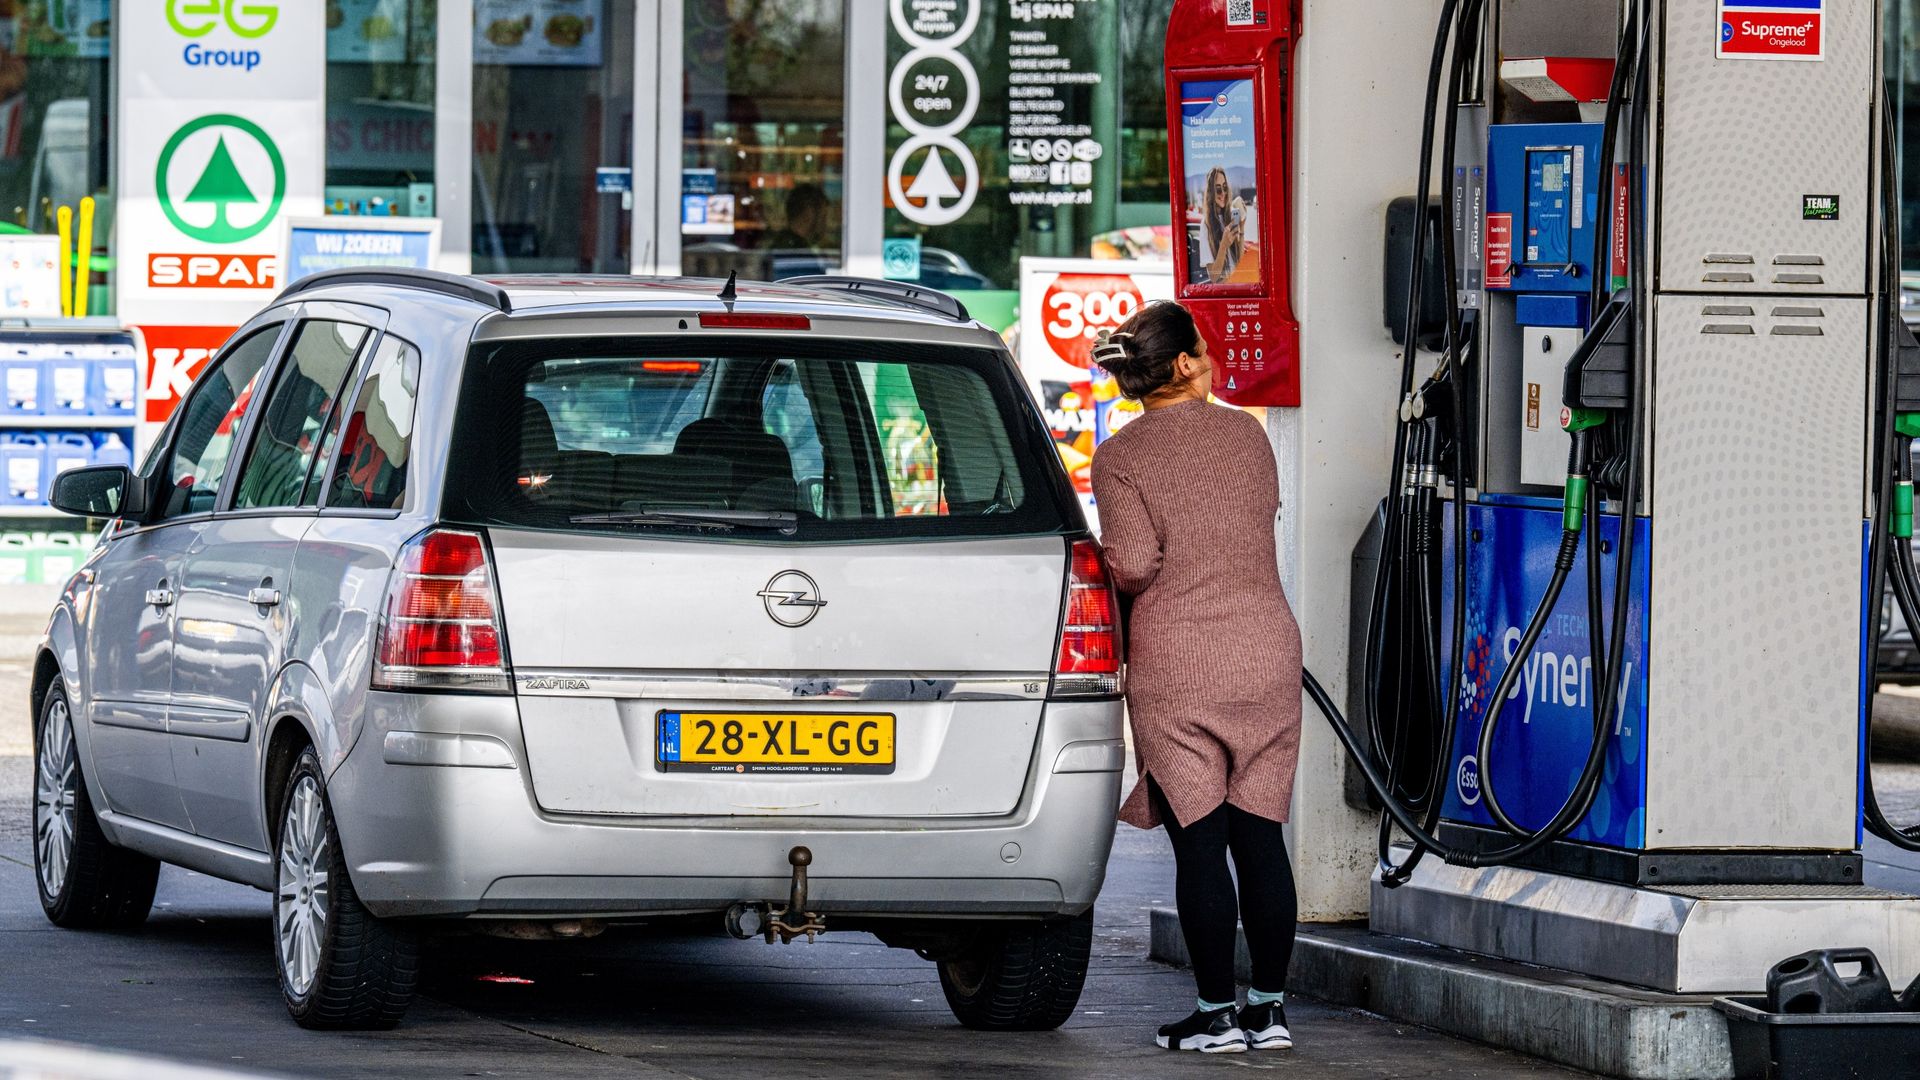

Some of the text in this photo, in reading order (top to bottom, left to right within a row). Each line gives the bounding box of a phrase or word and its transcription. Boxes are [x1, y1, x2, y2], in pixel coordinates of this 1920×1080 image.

[919, 10, 948, 22] Delft
[1032, 4, 1075, 19] SPAR
[1009, 31, 1047, 42] TANKEN
[1769, 37, 1806, 48] Ongelood
[1024, 45, 1058, 56] BAKKER
[183, 43, 261, 72] Group
[914, 75, 949, 93] 24/7
[1009, 86, 1054, 98] BLOEMEN
[913, 97, 952, 113] open
[1009, 189, 1092, 208] www.spar.nl
[1806, 197, 1831, 209] TEAM
[315, 233, 403, 255] WIJ ZOEKEN
[525, 679, 591, 690] ZAFIRA
[1503, 626, 1632, 736] Synery
[695, 719, 880, 756] 28-XL-GG
[661, 742, 678, 754] NL
